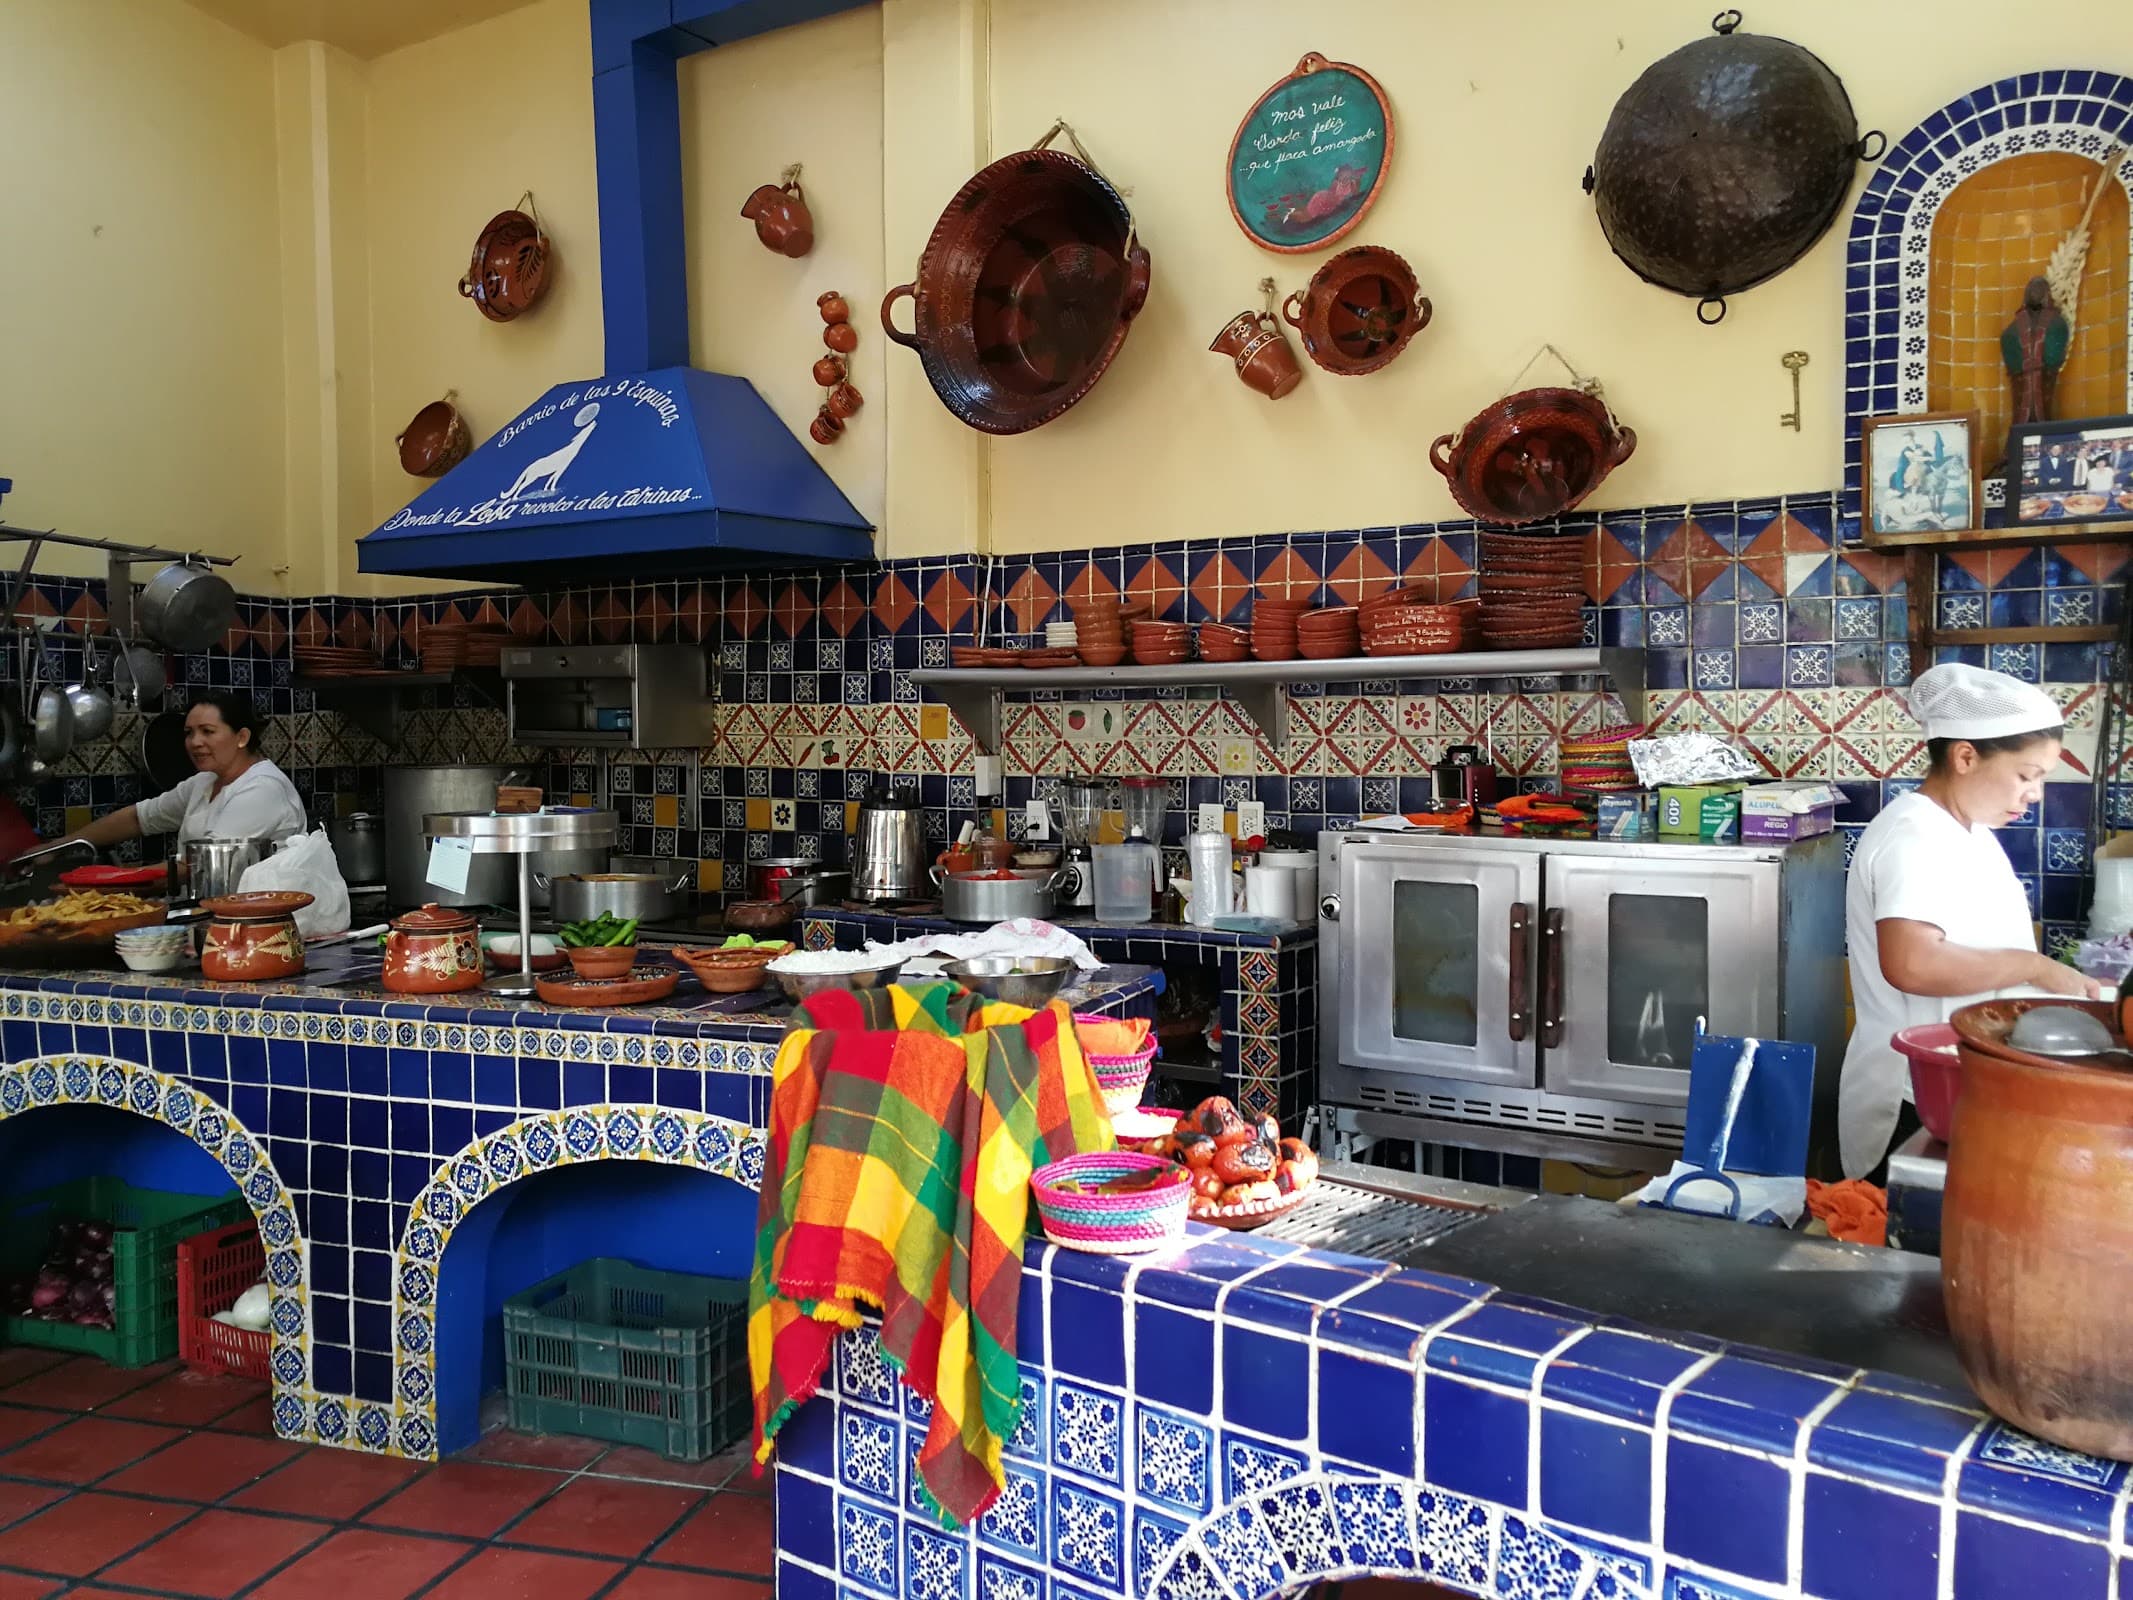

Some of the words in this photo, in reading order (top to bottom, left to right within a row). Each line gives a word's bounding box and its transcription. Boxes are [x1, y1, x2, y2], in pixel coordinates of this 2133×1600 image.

[1312, 94, 1346, 115] vale
[1310, 116, 1346, 145] feliz
[1274, 150, 1308, 175] flaca
[1312, 127, 1377, 156] amargada
[497, 404, 557, 448] Barrio
[559, 392, 580, 411] de
[583, 385, 610, 402] las
[612, 379, 630, 396] 9
[626, 379, 680, 429] Esquinas
[383, 507, 444, 531] Donde
[443, 506, 463, 524] la
[453, 498, 519, 527] Loba
[573, 497, 591, 511] a
[588, 490, 618, 510] las
[1668, 797, 1681, 827] 400
[1764, 821, 1789, 830] REGIO
